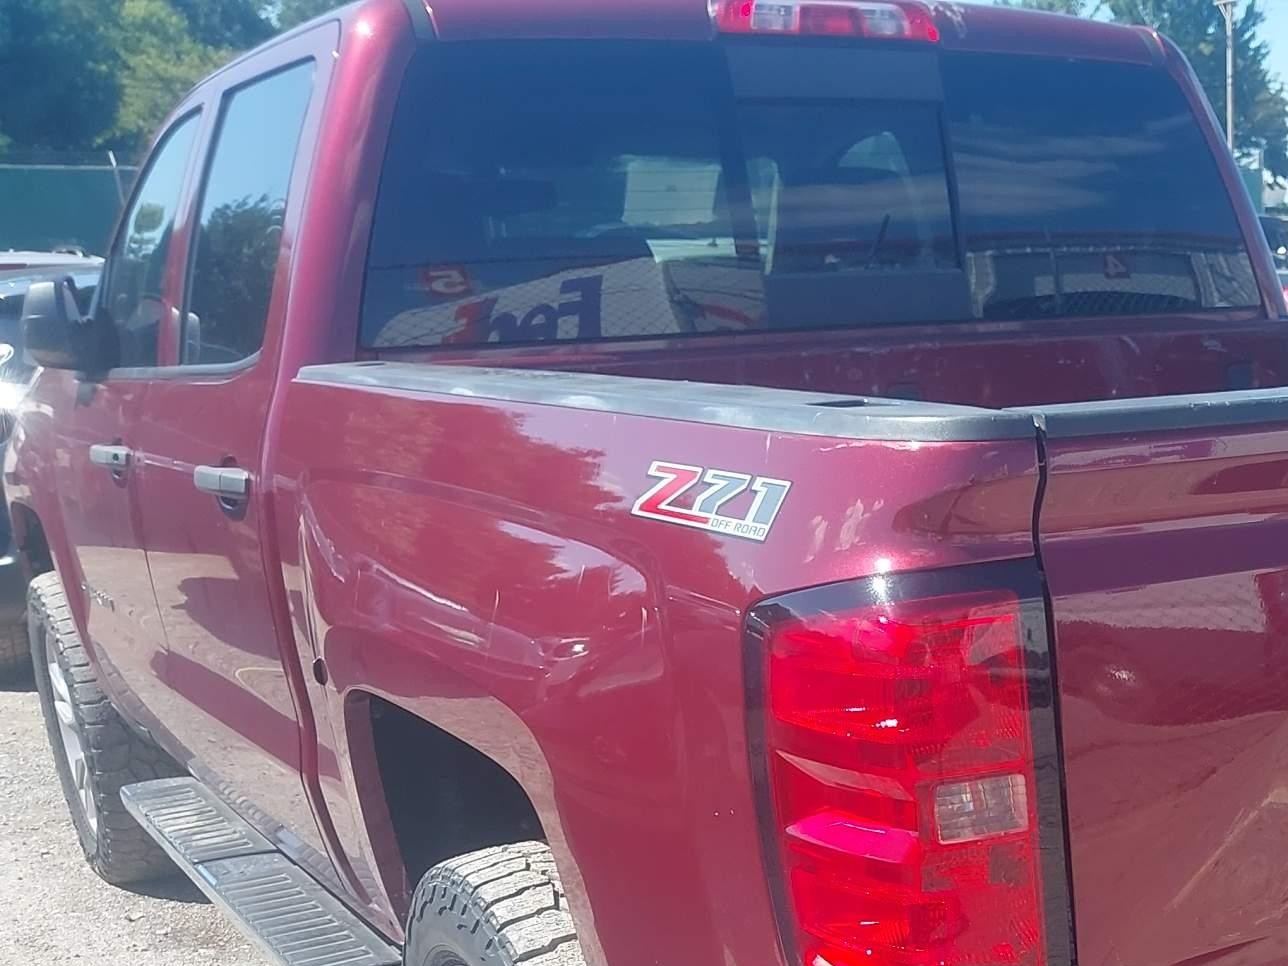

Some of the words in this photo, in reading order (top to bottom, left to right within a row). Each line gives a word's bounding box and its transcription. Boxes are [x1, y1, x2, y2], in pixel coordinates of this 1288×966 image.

[632, 461, 792, 527] Z71
[710, 517, 732, 529] OFF
[733, 523, 766, 538] ROAD
